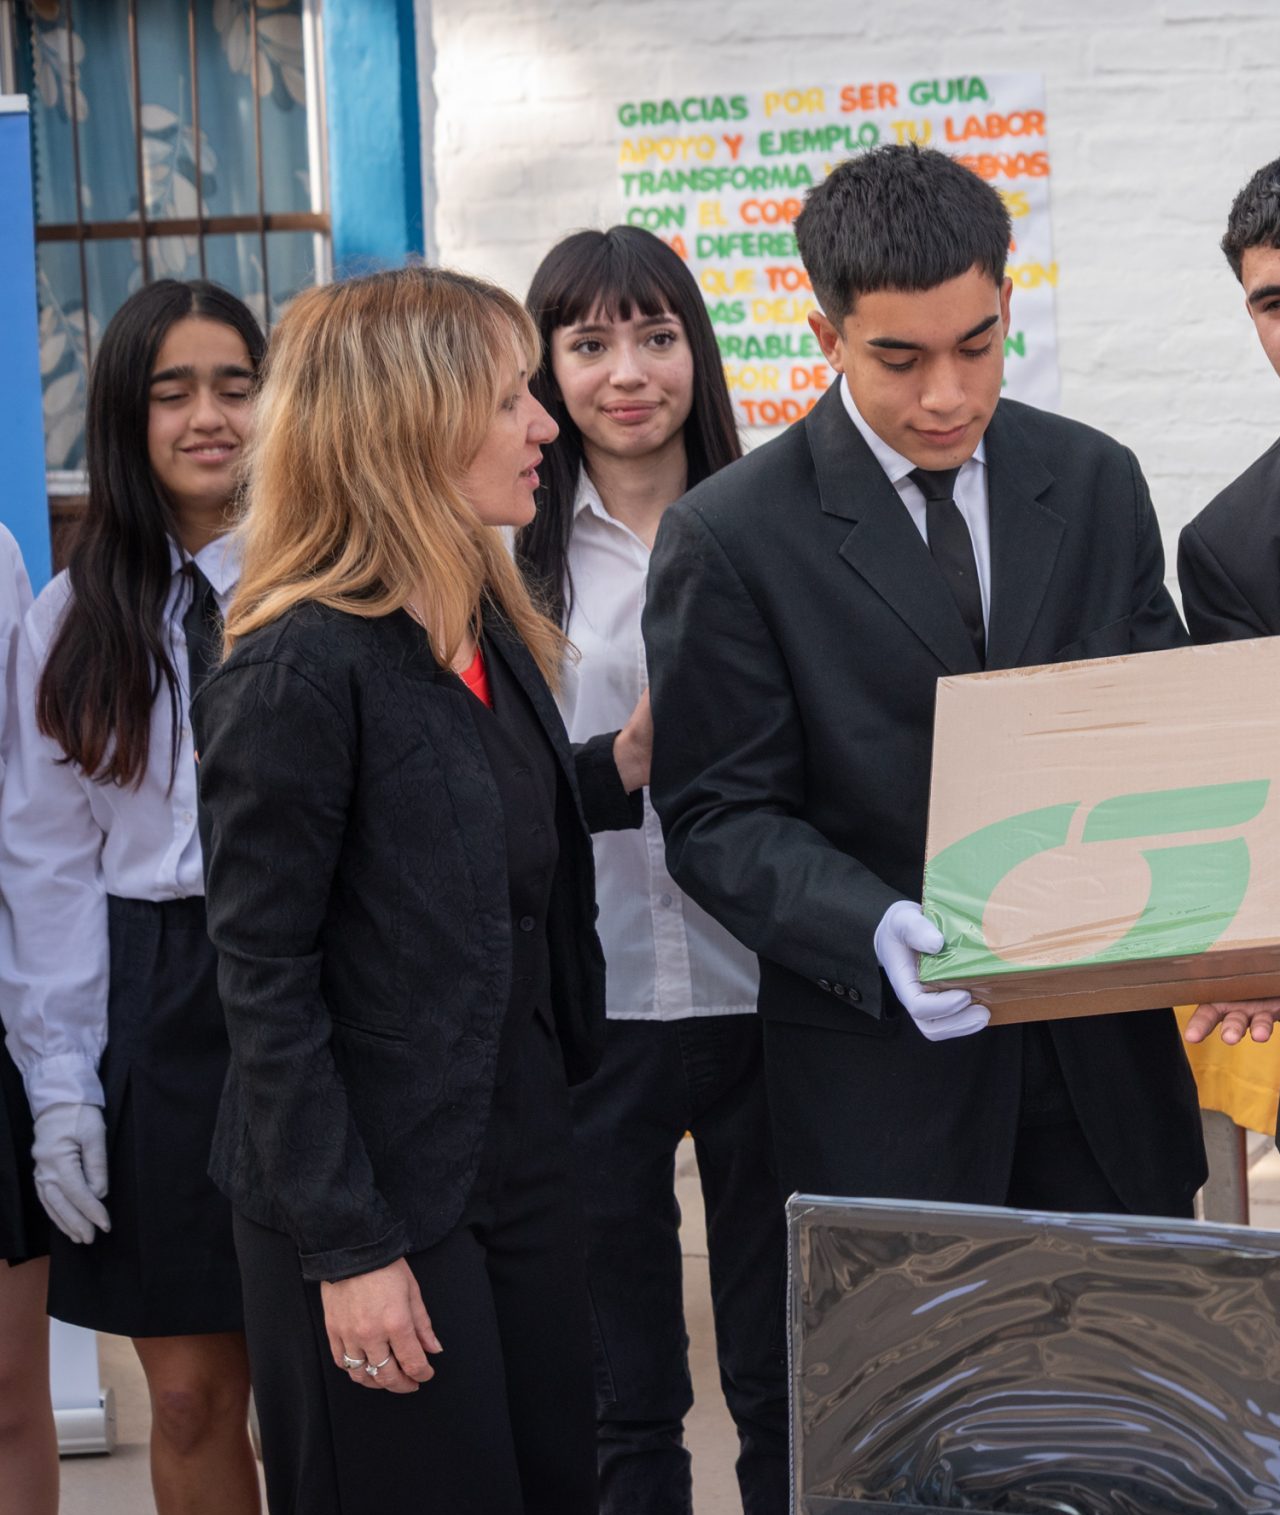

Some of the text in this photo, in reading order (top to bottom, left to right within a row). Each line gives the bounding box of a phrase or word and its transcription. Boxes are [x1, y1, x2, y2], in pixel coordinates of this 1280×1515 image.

[618, 95, 749, 127] GRACIAS
[763, 88, 825, 118] POR
[840, 82, 899, 113] SER
[620, 110, 1046, 163] APOYO Y EJEMPLO TU LABOR
[621, 164, 812, 195] TRANSFORMA
[627, 204, 686, 230] CON
[698, 200, 728, 227] EL
[700, 267, 755, 296] QUE
